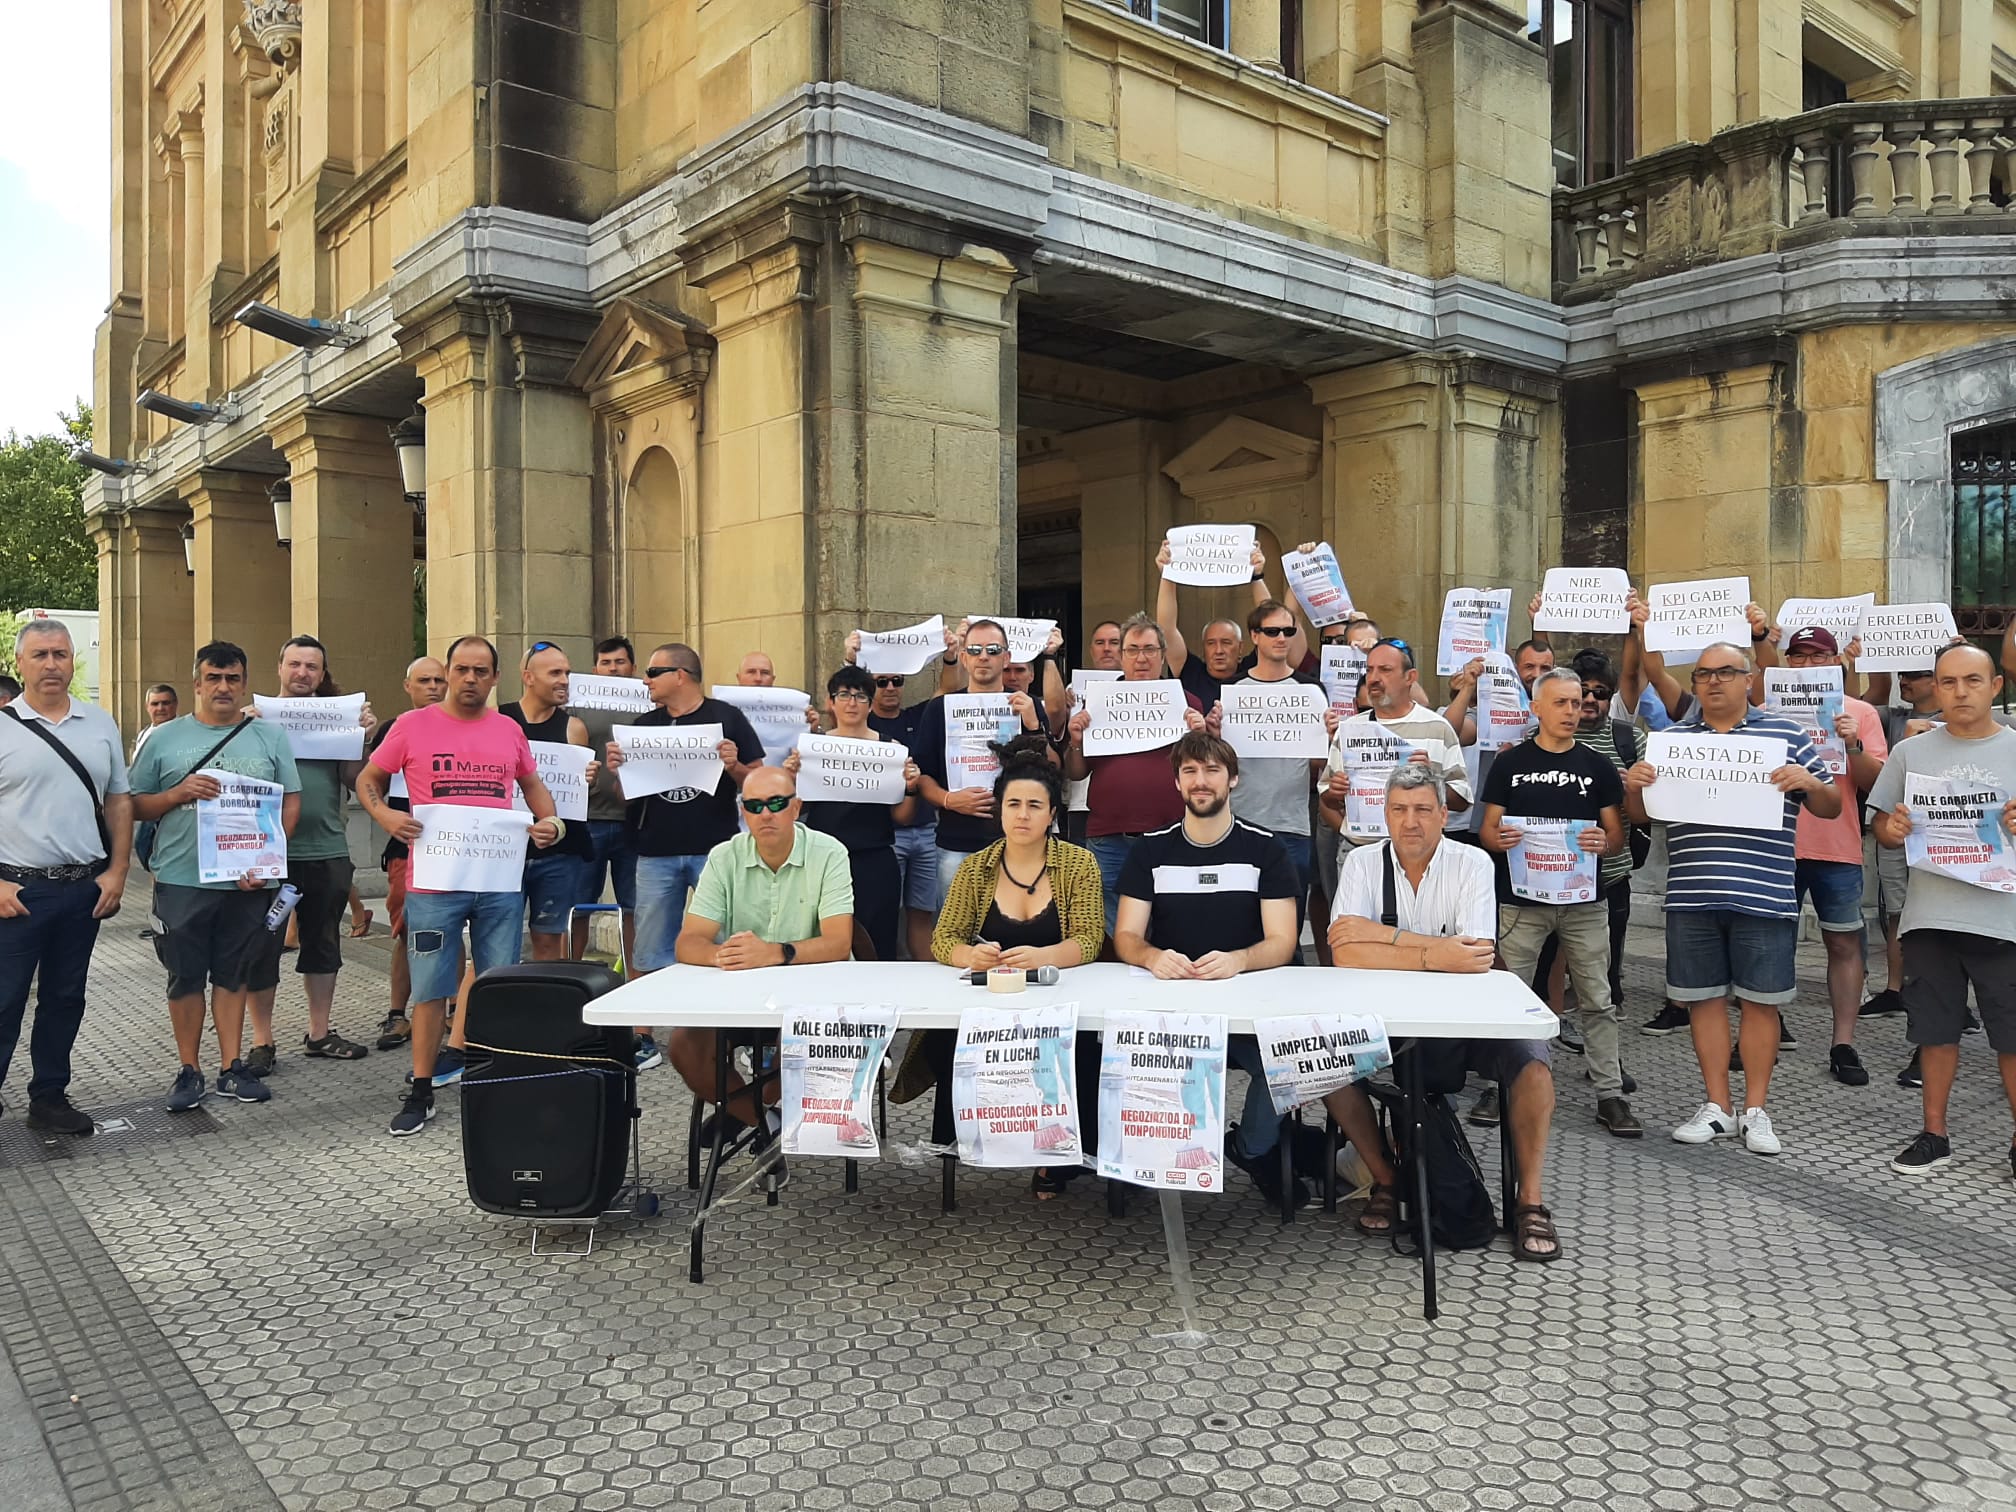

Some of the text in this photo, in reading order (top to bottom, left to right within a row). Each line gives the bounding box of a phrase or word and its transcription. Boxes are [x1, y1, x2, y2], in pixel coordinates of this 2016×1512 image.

[1219, 534, 1240, 546] IPC
[1185, 547, 1235, 559] NO HAY
[1170, 560, 1248, 574] CONVENIO!!
[1569, 577, 1602, 588] NIRE
[1544, 592, 1624, 604] KATEGORIA
[1662, 589, 1732, 606] KPI GABE
[1544, 607, 1621, 620] NAHI DUT!!
[1652, 604, 1744, 622] HITZARMEN
[1796, 604, 1860, 615] KPI GABE
[1867, 613, 1945, 627] ERRELEBU
[1008, 625, 1035, 638] HAY
[1670, 623, 1725, 636] -IK EZ!!
[1863, 629, 1951, 642] KONTRATUA
[874, 633, 930, 646] GEROA
[1008, 640, 1046, 652] ENIO!!
[1330, 659, 1345, 667] KALE
[1337, 672, 1358, 680] BORRO
[1486, 666, 1499, 674] KALE
[577, 684, 630, 697] QUIERO
[1772, 683, 1788, 693] KALE
[1105, 692, 1169, 707] ¡¡SIN IPC
[1238, 696, 1310, 709] KPI GABE
[1781, 697, 1824, 706] BORROKAN
[739, 704, 794, 713] ESKANTSO
[952, 708, 985, 718] LIMPIEZA
[280, 710, 343, 721] DESCANSO
[1108, 710, 1167, 722] NO HAY
[1229, 713, 1321, 724] HITZARMEN
[966, 721, 1000, 731] EN LUCHA
[1092, 727, 1184, 740] CONVENIO!!
[1248, 730, 1302, 741] -IK EZ!!
[631, 737, 708, 749] BASTA DE
[811, 741, 896, 758] CONTRATO
[1347, 738, 1382, 748] LIMPIEZA
[533, 752, 559, 766] IRE
[624, 752, 718, 763] PARCIALIDAD
[1361, 752, 1400, 762] EN LUCHA
[1668, 746, 1764, 765] BASTA DE
[821, 758, 884, 774] RELEVO
[538, 771, 581, 786] GORIA
[1656, 765, 1772, 784] PARCIALIDAD
[823, 776, 880, 790] SI O SI!!
[549, 790, 579, 803] UT!!
[1708, 787, 1718, 799] !!
[1912, 792, 1998, 806] KALE GARBIKETA
[1928, 810, 1984, 820] BORROKAN
[473, 818, 480, 829] 2
[438, 831, 511, 845] DESKANTSO
[426, 845, 517, 860] EGUN ASTEAN!!
[1982, 844, 1993, 854] DA
[793, 1021, 887, 1039] KALE GARBIKETA
[966, 1026, 1060, 1044] LIMPIEZA VIARIA
[1117, 1031, 1211, 1050] KALE GARBIKETA
[1271, 1028, 1370, 1057] LIMPIEZA VIARIA
[808, 1044, 869, 1060] BORROKAN
[986, 1047, 1040, 1063] EN LUCHA
[1131, 1053, 1193, 1070] BORROKAN
[1298, 1054, 1356, 1073] EN LUCHA
[960, 1103, 1068, 1120] ¡LA NEGOCIACIÓN ES LA
[1121, 1110, 1196, 1125] NEGOZIAZIOA DA
[990, 1117, 1039, 1133] SOLUCIÓN!
[1124, 1125, 1192, 1140] KONPONBIDEA!
[1135, 1170, 1154, 1180] LAB
